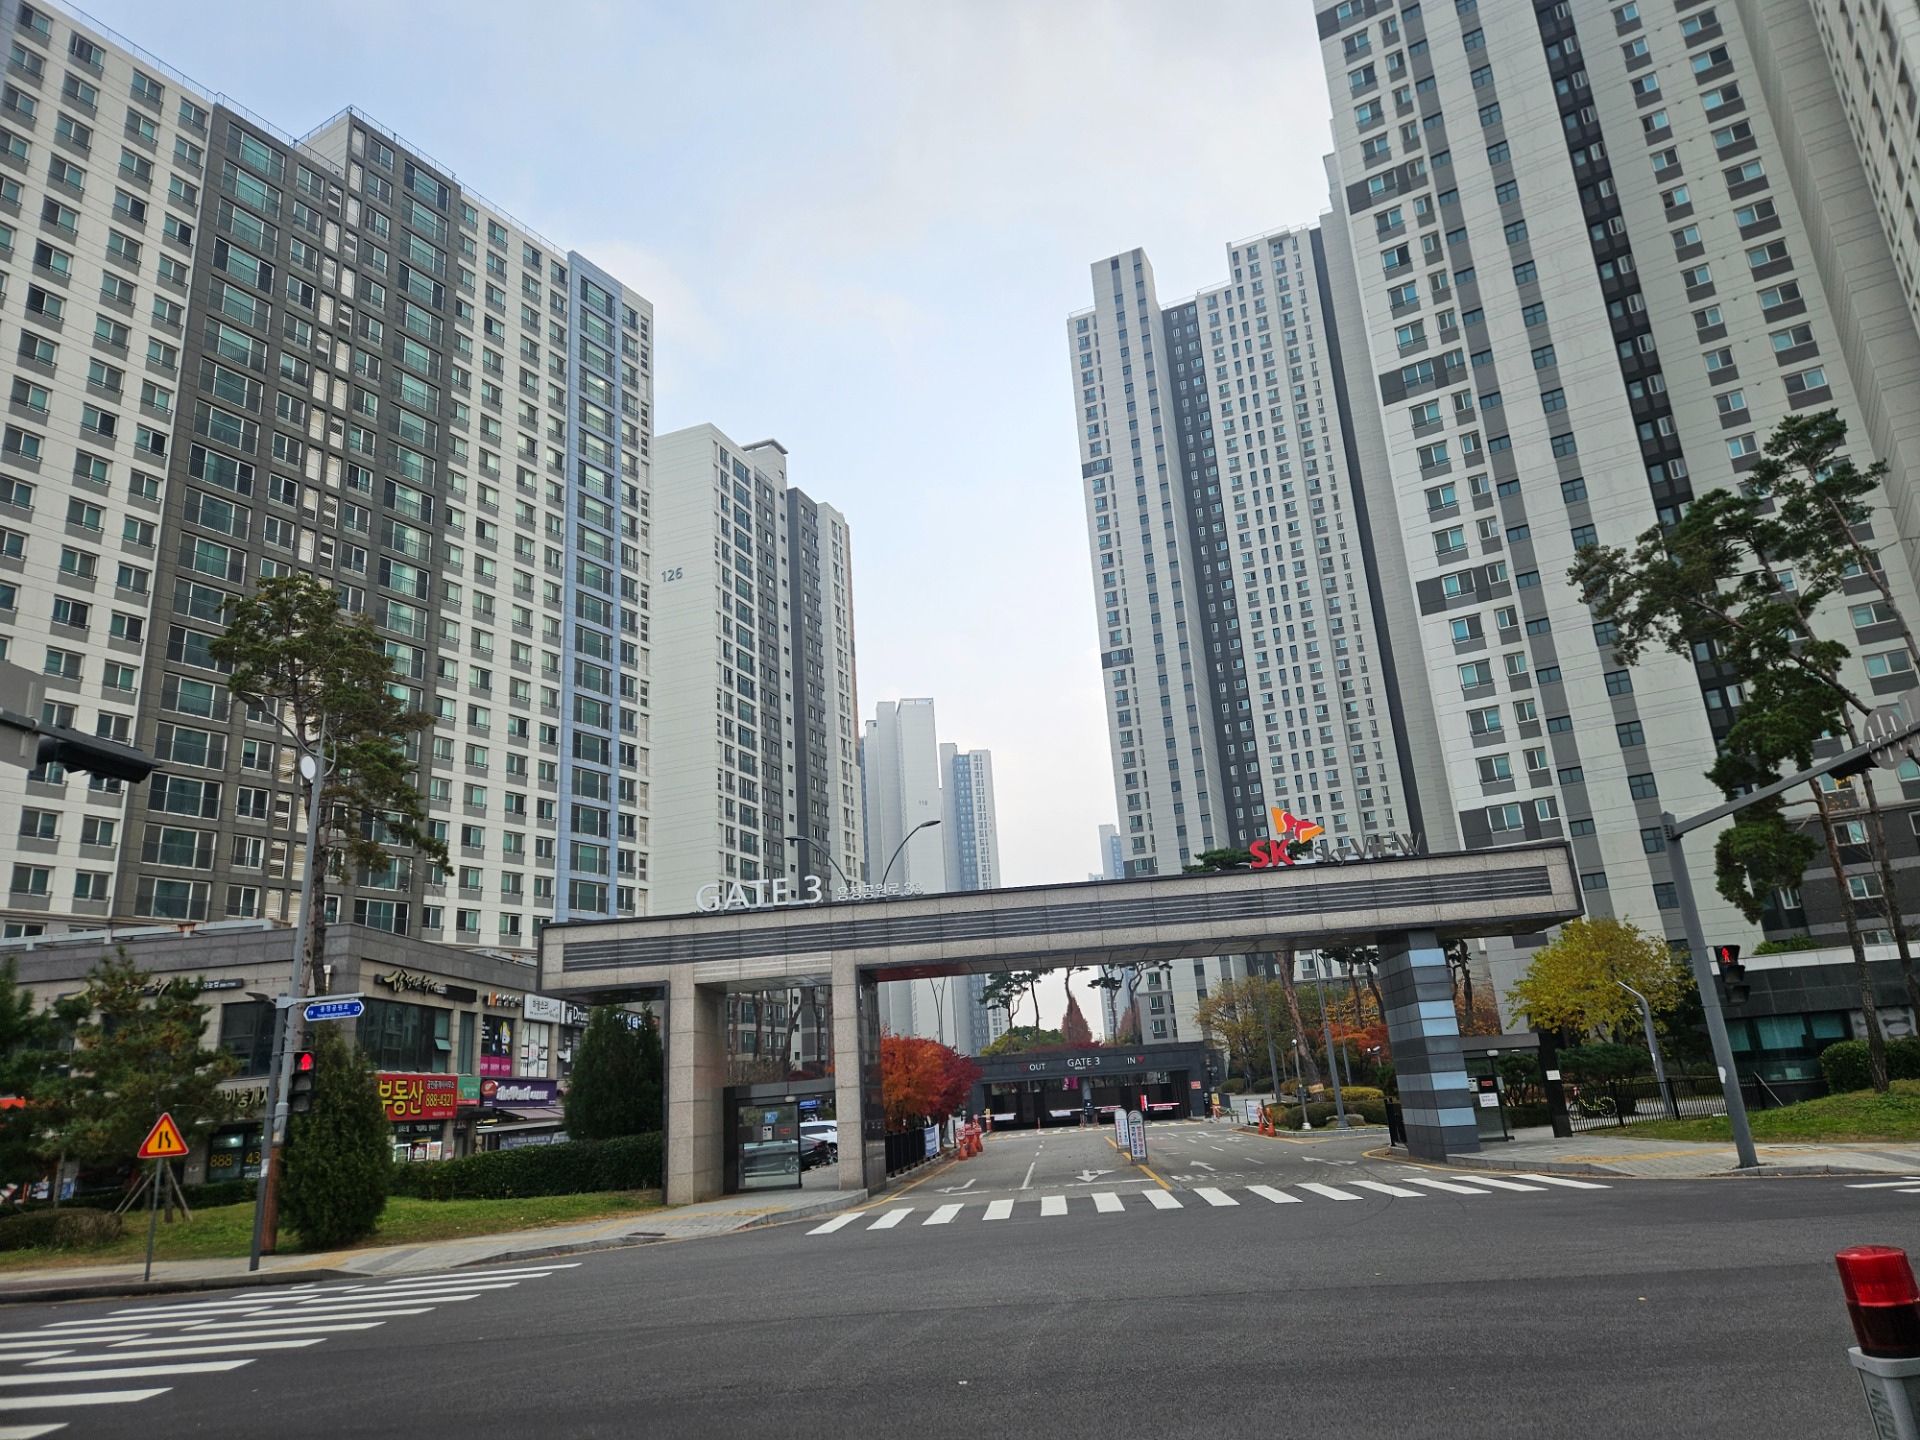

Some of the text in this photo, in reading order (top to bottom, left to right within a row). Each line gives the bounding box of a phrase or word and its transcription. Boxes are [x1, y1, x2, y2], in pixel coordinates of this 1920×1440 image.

[661, 567, 683, 582] 126
[1250, 832, 1421, 868] SK Sky VIEW
[696, 875, 822, 912] GATE 3
[837, 883, 899, 900] 용정공원로
[1029, 1063, 1046, 1071] OUT
[1067, 1056, 1101, 1068] GATE 3
[1127, 1057, 1136, 1065] IN
[378, 1080, 424, 1115] 부동산
[425, 1093, 453, 1107] 888-4321
